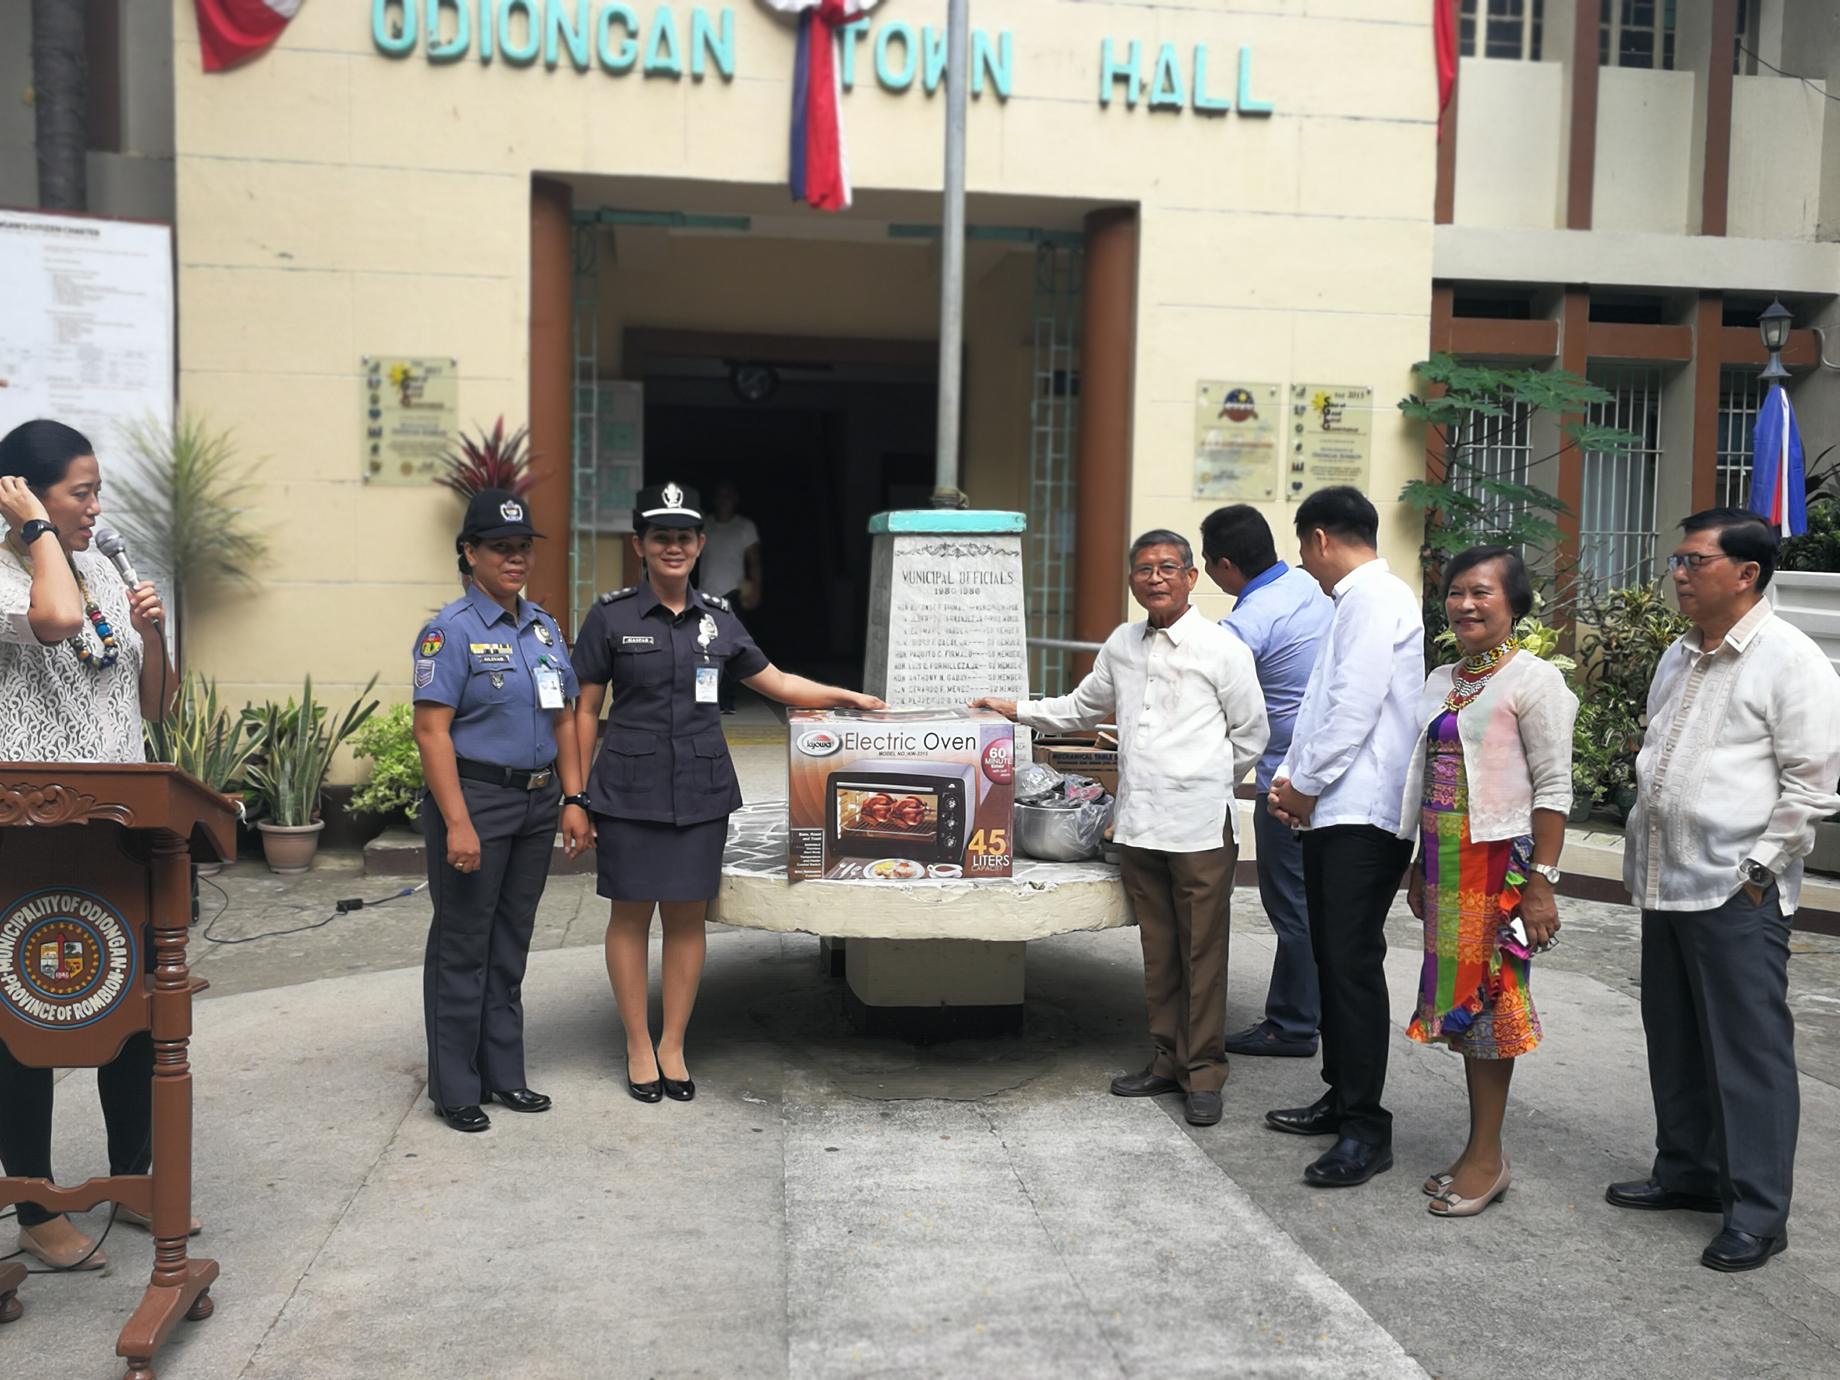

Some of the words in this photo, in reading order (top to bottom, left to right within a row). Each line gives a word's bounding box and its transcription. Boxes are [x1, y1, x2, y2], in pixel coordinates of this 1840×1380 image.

[372, 0, 736, 83] ODIONGAN
[1099, 37, 1274, 115] HALL
[902, 571, 954, 584] MUNICIPAL
[960, 571, 1014, 585] OFFICIALS
[845, 731, 916, 751] Electric
[923, 731, 976, 751] Oven
[985, 757, 1012, 765] MINUTE
[989, 747, 1006, 758] 60
[968, 828, 1007, 856] 45
[973, 855, 1010, 867] LITERS
[61, 896, 81, 912] OF
[79, 900, 128, 969] ODIONGAN
[1, 974, 55, 1021] PROVINCE
[57, 1005, 73, 1021] OF
[72, 974, 125, 1020] ROMBLON
